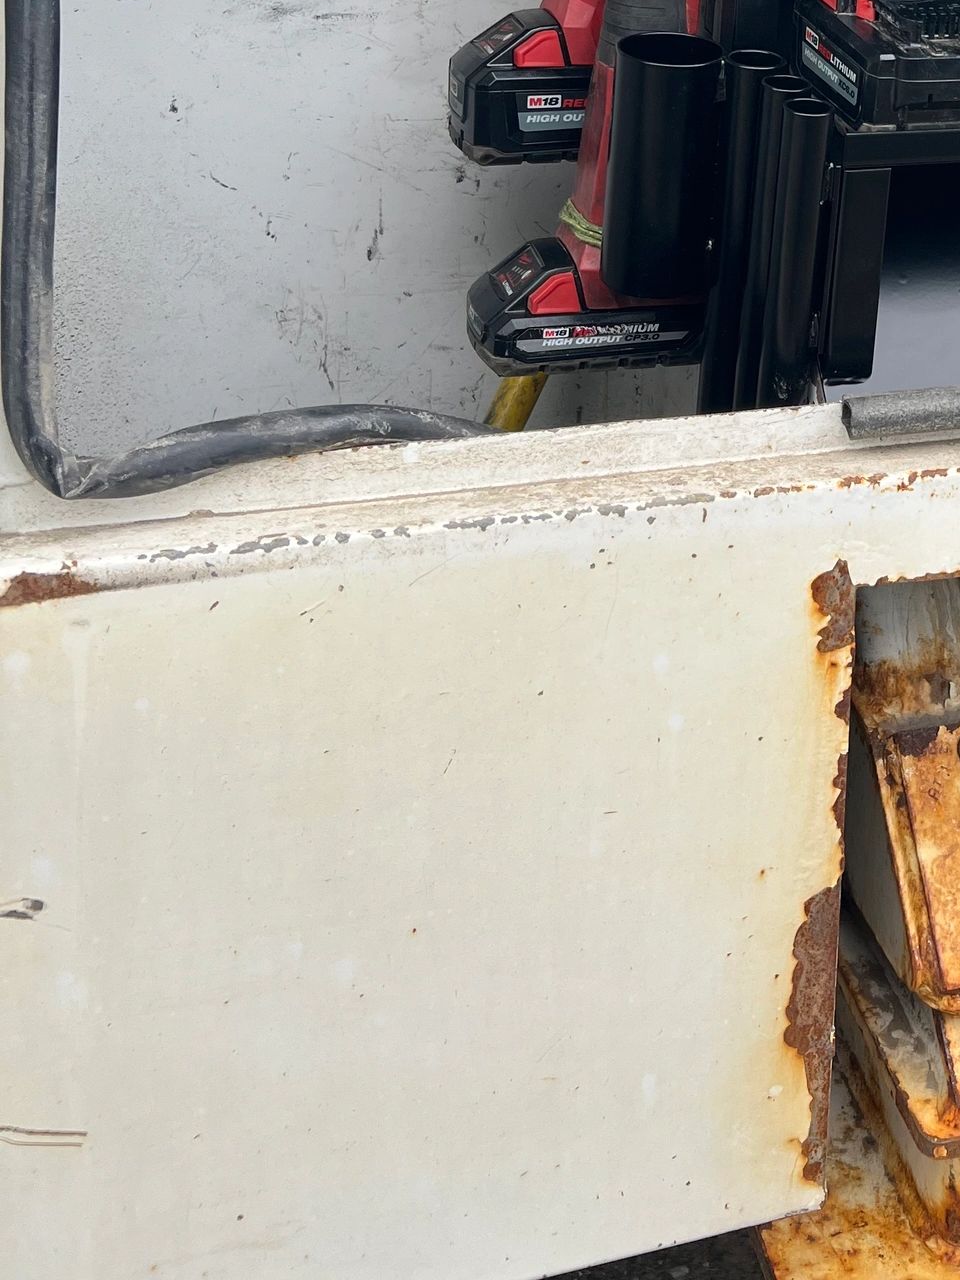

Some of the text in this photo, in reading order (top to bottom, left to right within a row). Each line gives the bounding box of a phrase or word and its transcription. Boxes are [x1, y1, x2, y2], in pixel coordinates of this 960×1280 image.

[804, 47, 818, 65] HIGH
[817, 60, 839, 83] OUTPUT
[528, 96, 561, 108] M18
[526, 114, 560, 124] HIGH
[544, 329, 568, 338] M18
[542, 333, 660, 347] HIGH OUTPUT CP3.0
